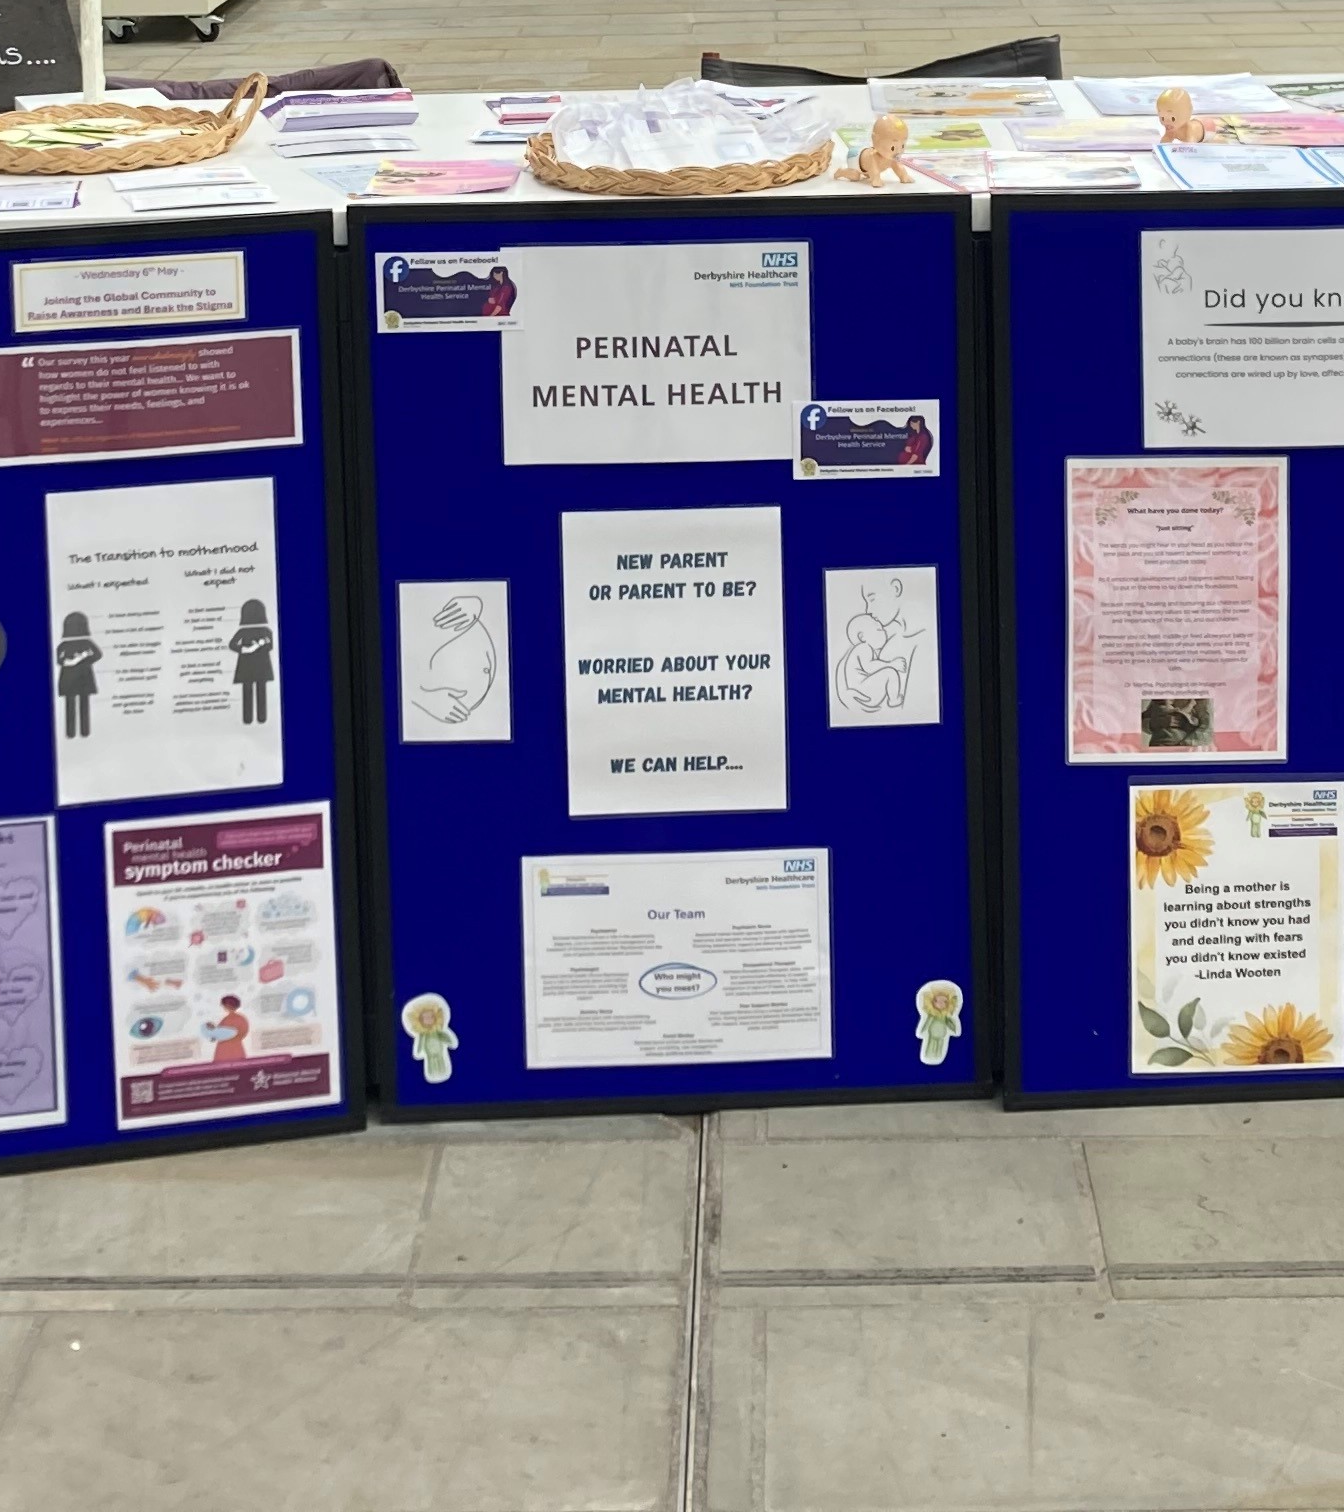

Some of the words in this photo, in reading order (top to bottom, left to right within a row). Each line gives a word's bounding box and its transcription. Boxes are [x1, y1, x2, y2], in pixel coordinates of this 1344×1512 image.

[763, 254, 796, 266] NHS
[693, 270, 745, 282] Derbyshire
[747, 269, 799, 279] Healthcare
[1204, 288, 1246, 309] Did
[1255, 292, 1303, 315] you
[576, 334, 738, 359] PERINATAL
[532, 384, 656, 408] MENTAL
[667, 381, 782, 406] HEALTH
[68, 553, 92, 564] The
[94, 549, 157, 563] Transition
[158, 546, 175, 558] to
[177, 541, 259, 557] motherhood
[616, 553, 654, 571] NEW
[660, 551, 729, 569] PARENT
[588, 584, 612, 601] OR
[618, 582, 687, 601] PARENT
[692, 581, 716, 598] TO
[722, 580, 757, 597] BE?
[578, 656, 654, 676] WORRIED
[660, 655, 719, 673] ABOUT
[725, 653, 771, 671] YOUR
[597, 686, 667, 705] MENTAL
[672, 684, 753, 702] HEALTH?
[610, 757, 636, 774] WE
[641, 756, 677, 773] CAN
[122, 837, 183, 854] Perinatal
[125, 858, 208, 884] symptom
[213, 850, 283, 873] checker
[1185, 884, 1220, 896] Being
[1223, 885, 1231, 894] a
[1233, 882, 1277, 893] mother
[1279, 881, 1290, 891] is
[647, 909, 671, 920] Our
[673, 908, 706, 920] Team
[1194, 968, 1233, 980] -Linda
[1234, 967, 1281, 978] Wooten
